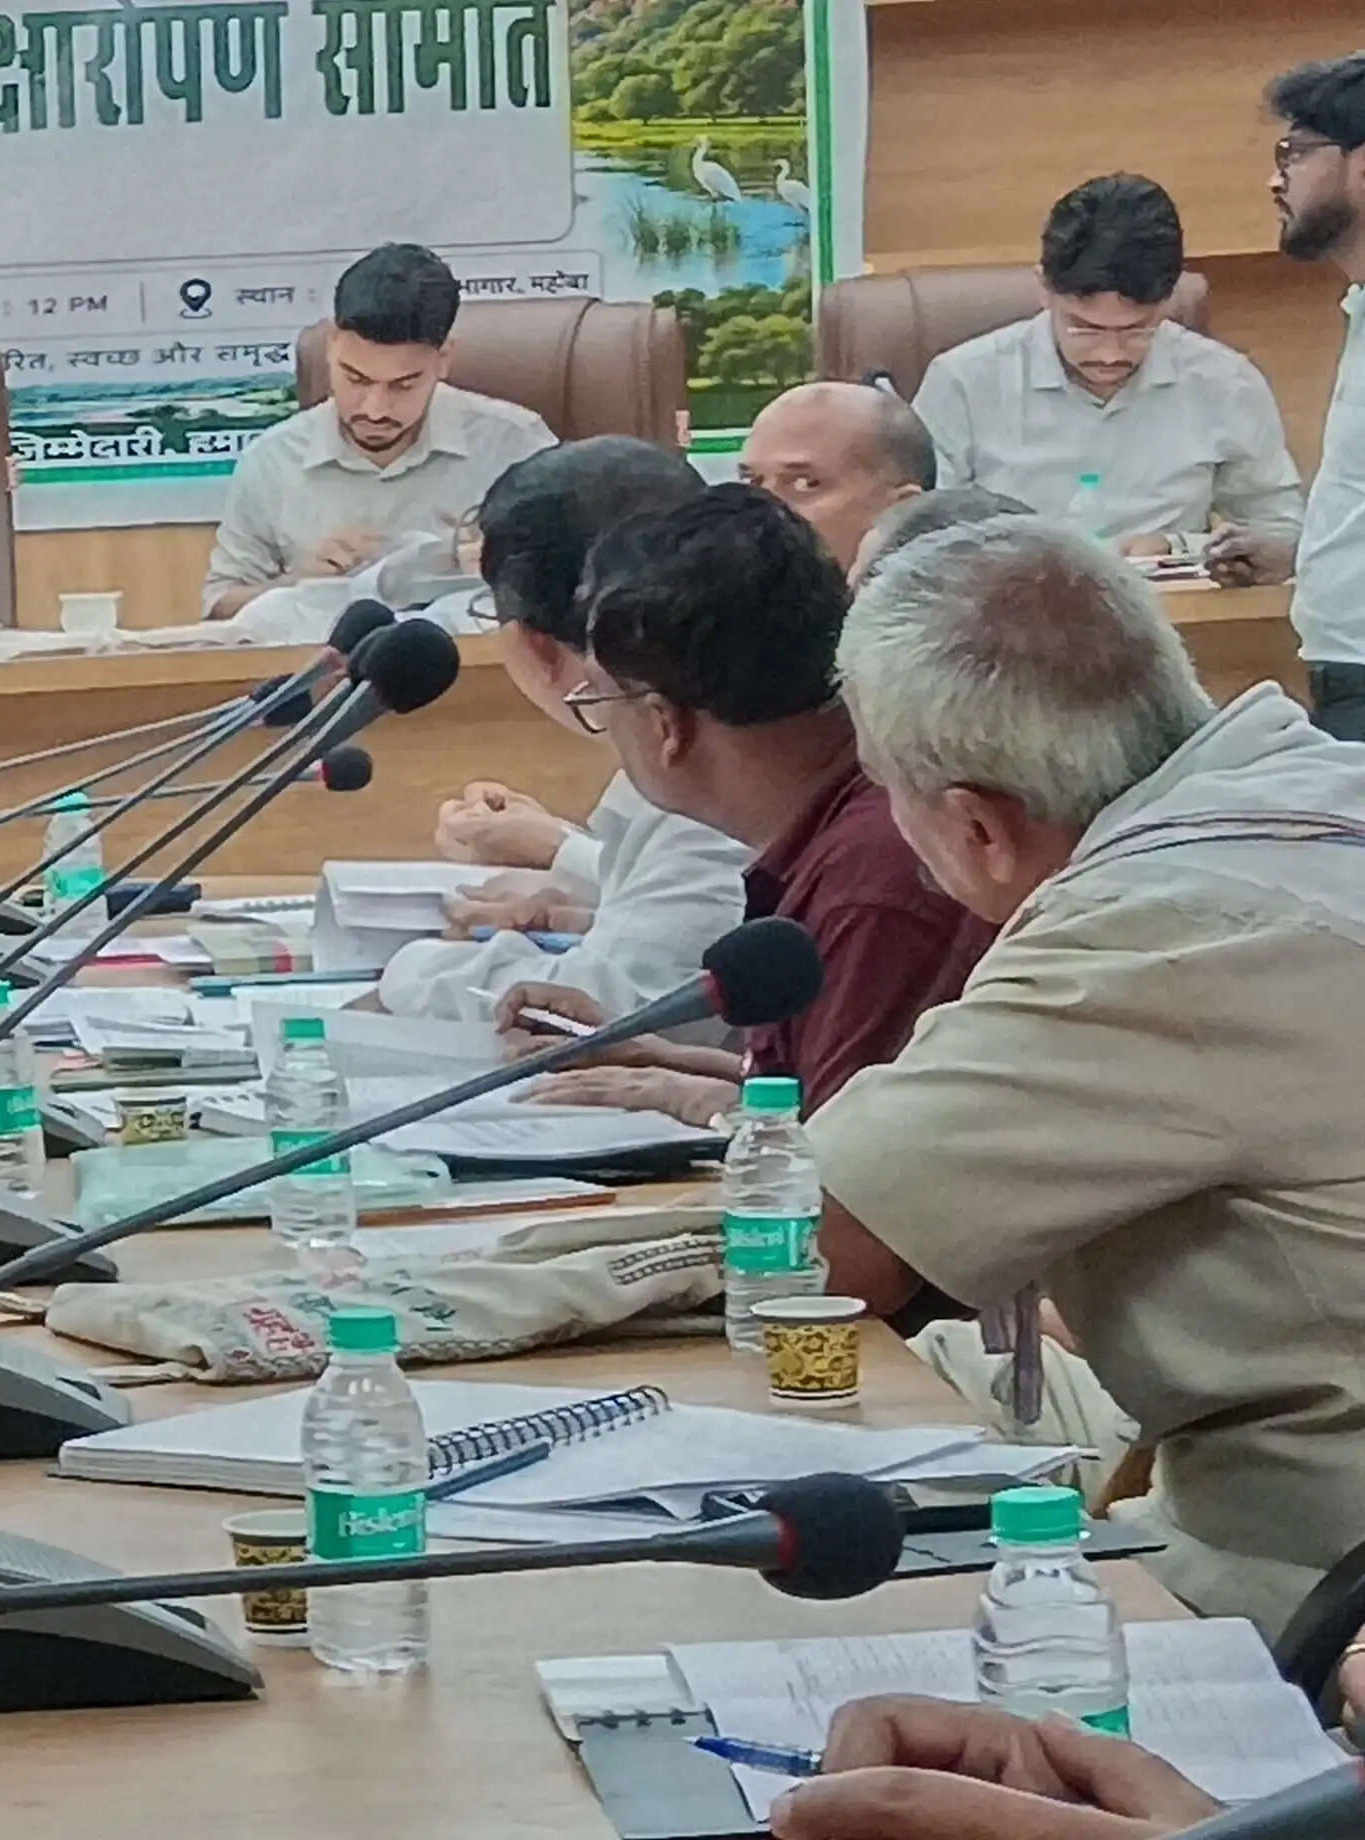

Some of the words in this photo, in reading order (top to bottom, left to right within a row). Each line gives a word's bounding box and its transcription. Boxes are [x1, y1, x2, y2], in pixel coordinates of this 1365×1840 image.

[28, 297, 58, 315] 12
[69, 295, 109, 312] PM
[234, 286, 296, 306] स्थान
[2, 348, 55, 372] रित,
[153, 341, 205, 365] और
